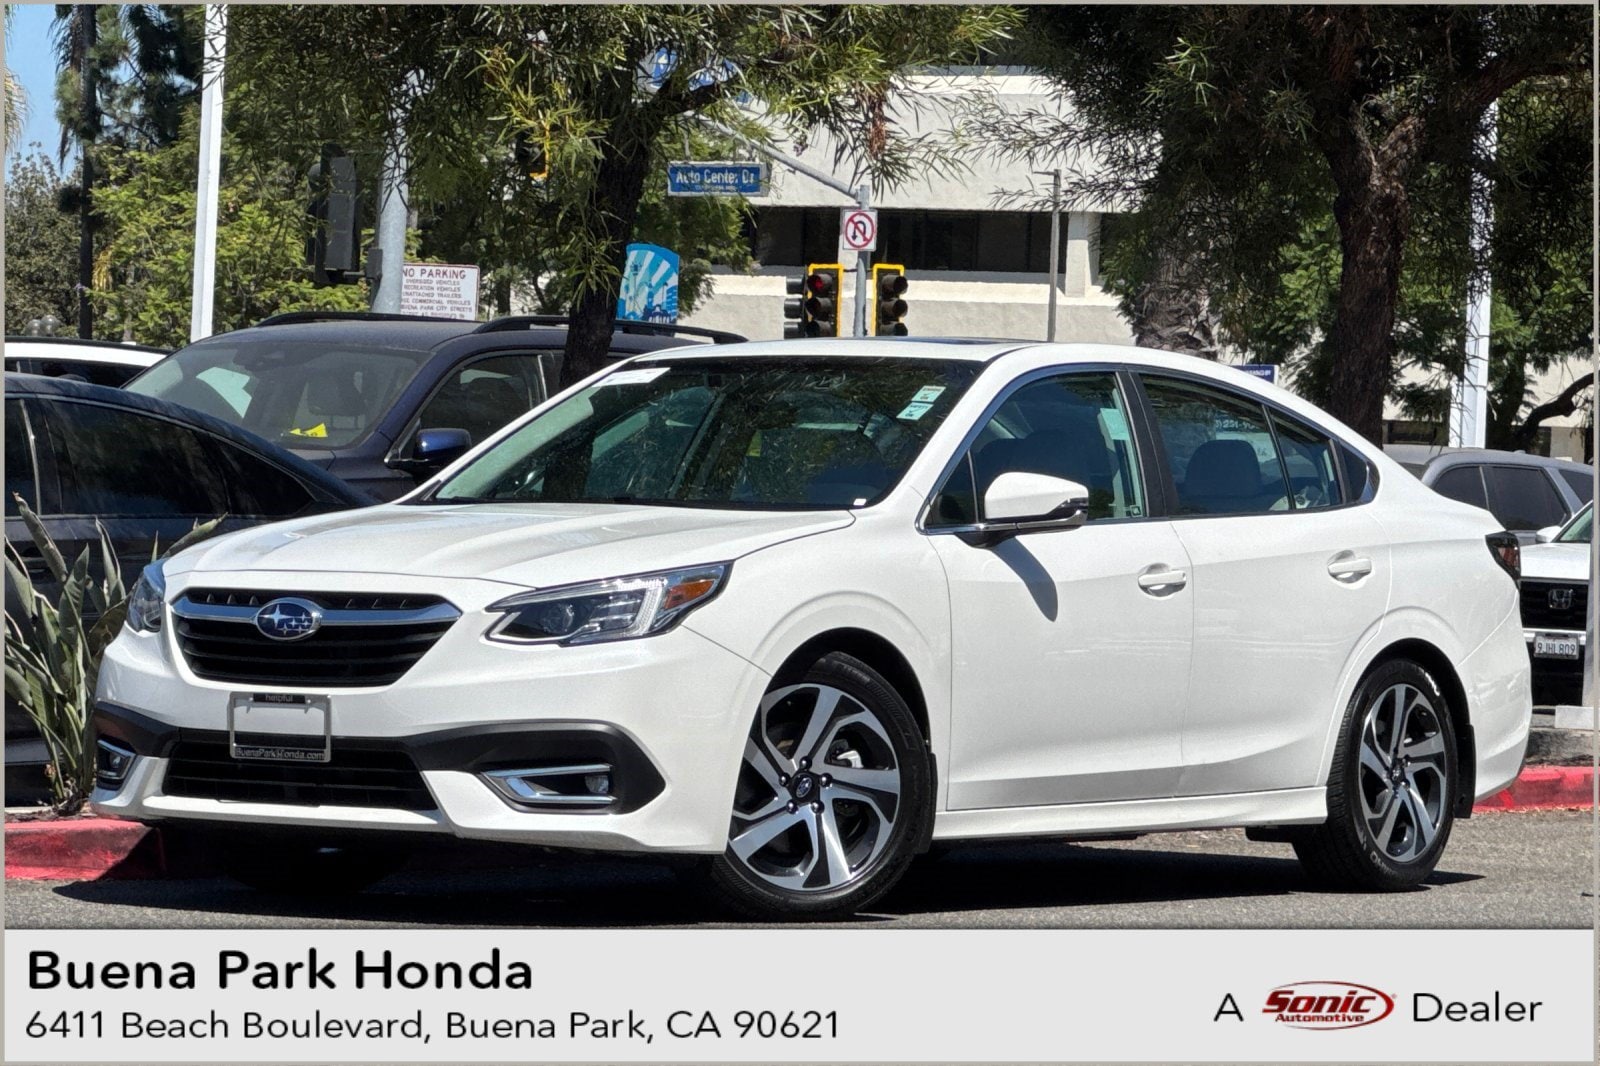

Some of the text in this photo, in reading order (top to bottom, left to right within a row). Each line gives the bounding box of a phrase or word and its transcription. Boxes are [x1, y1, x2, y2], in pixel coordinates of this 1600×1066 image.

[676, 169, 755, 184] Auto Center Dr
[402, 268, 467, 279] NO PARKING
